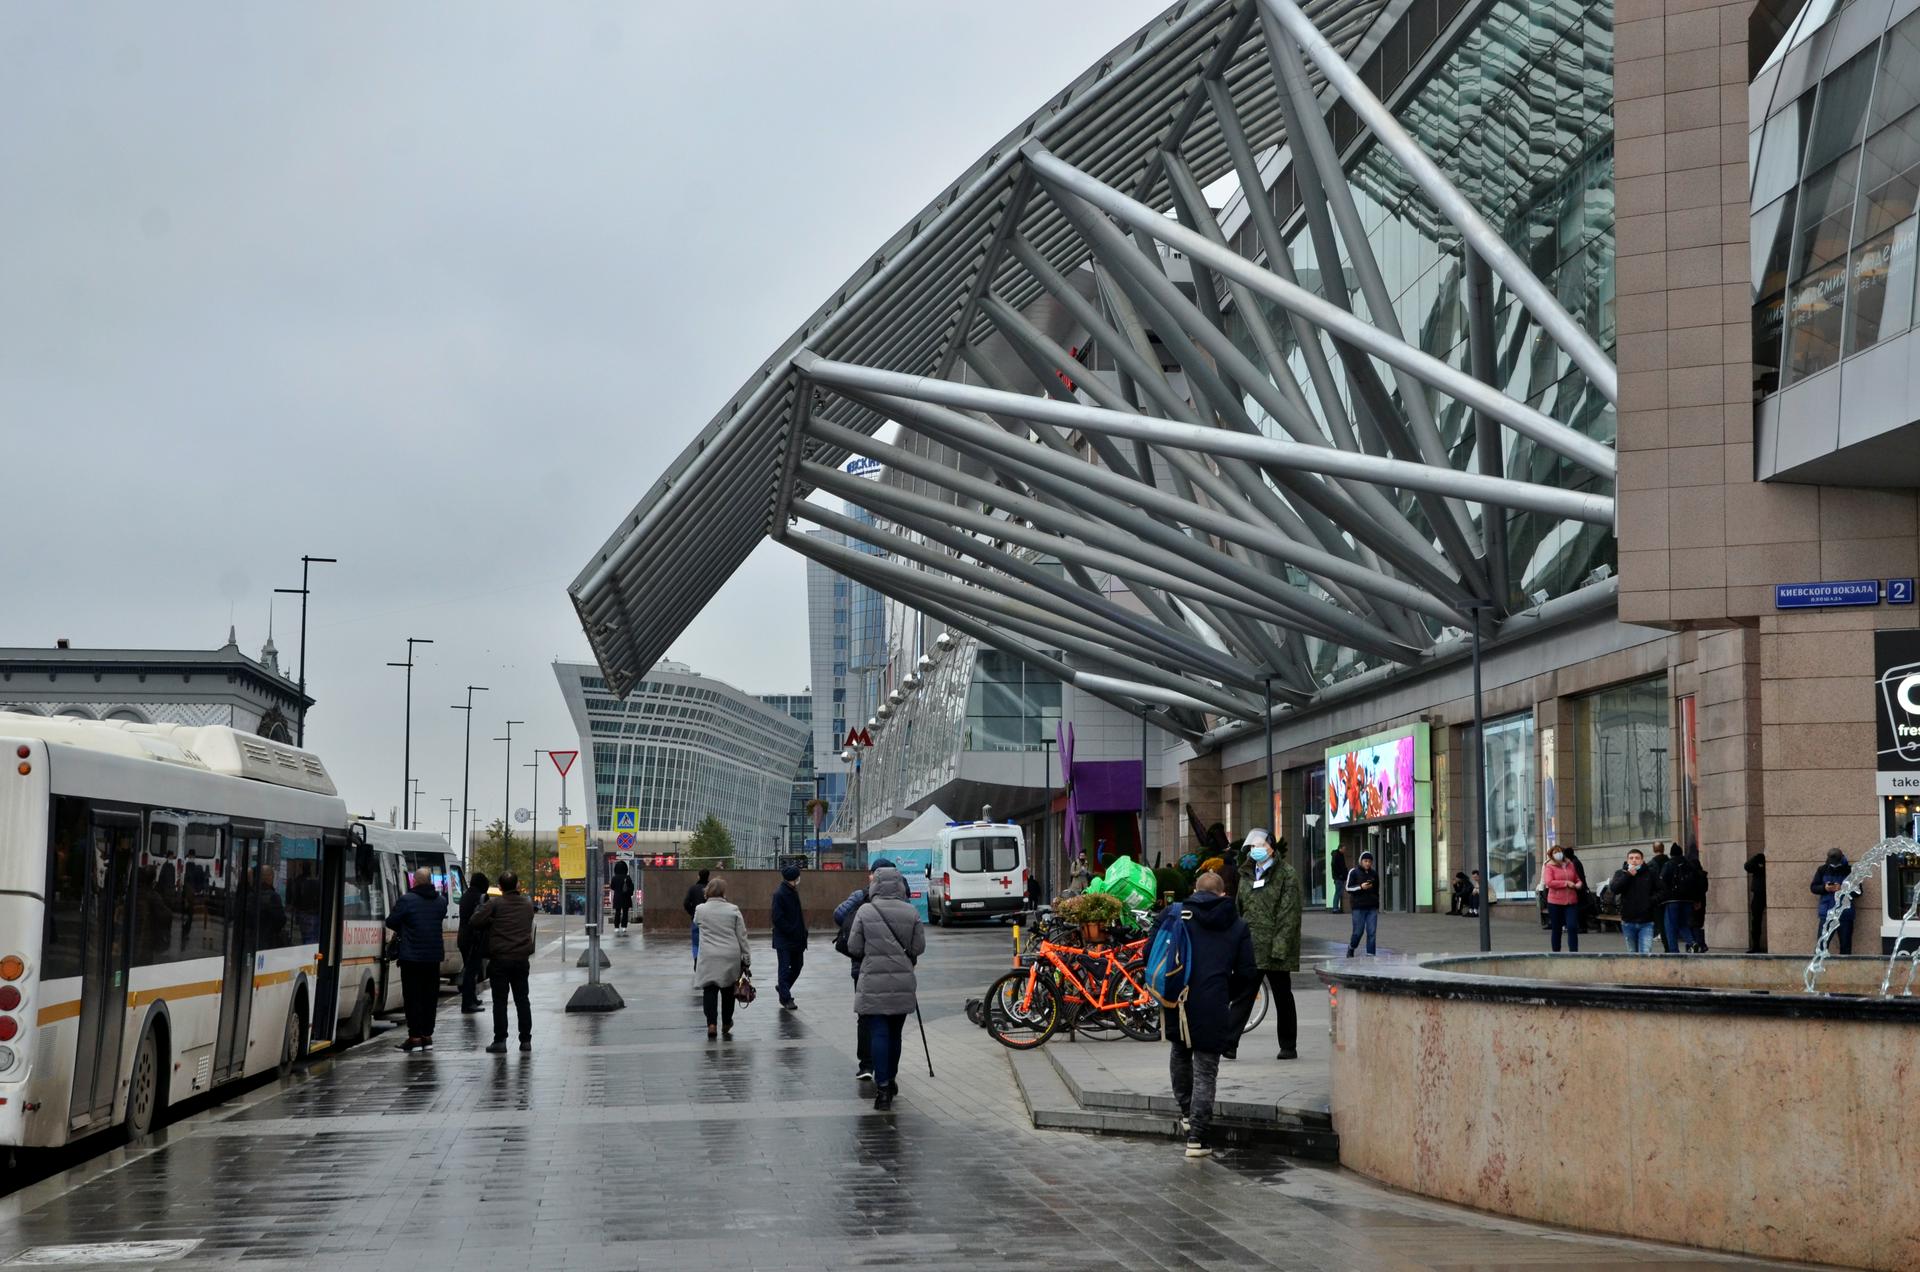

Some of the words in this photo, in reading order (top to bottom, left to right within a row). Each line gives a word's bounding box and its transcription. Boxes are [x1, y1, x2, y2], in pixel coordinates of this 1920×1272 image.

[1791, 269, 1846, 312] акемия
[1780, 587, 1832, 597] КИЕВСКОГО
[1832, 585, 1873, 594] ВОКЗАЛА
[1893, 582, 1905, 599] 2
[1891, 776, 1920, 787] take
